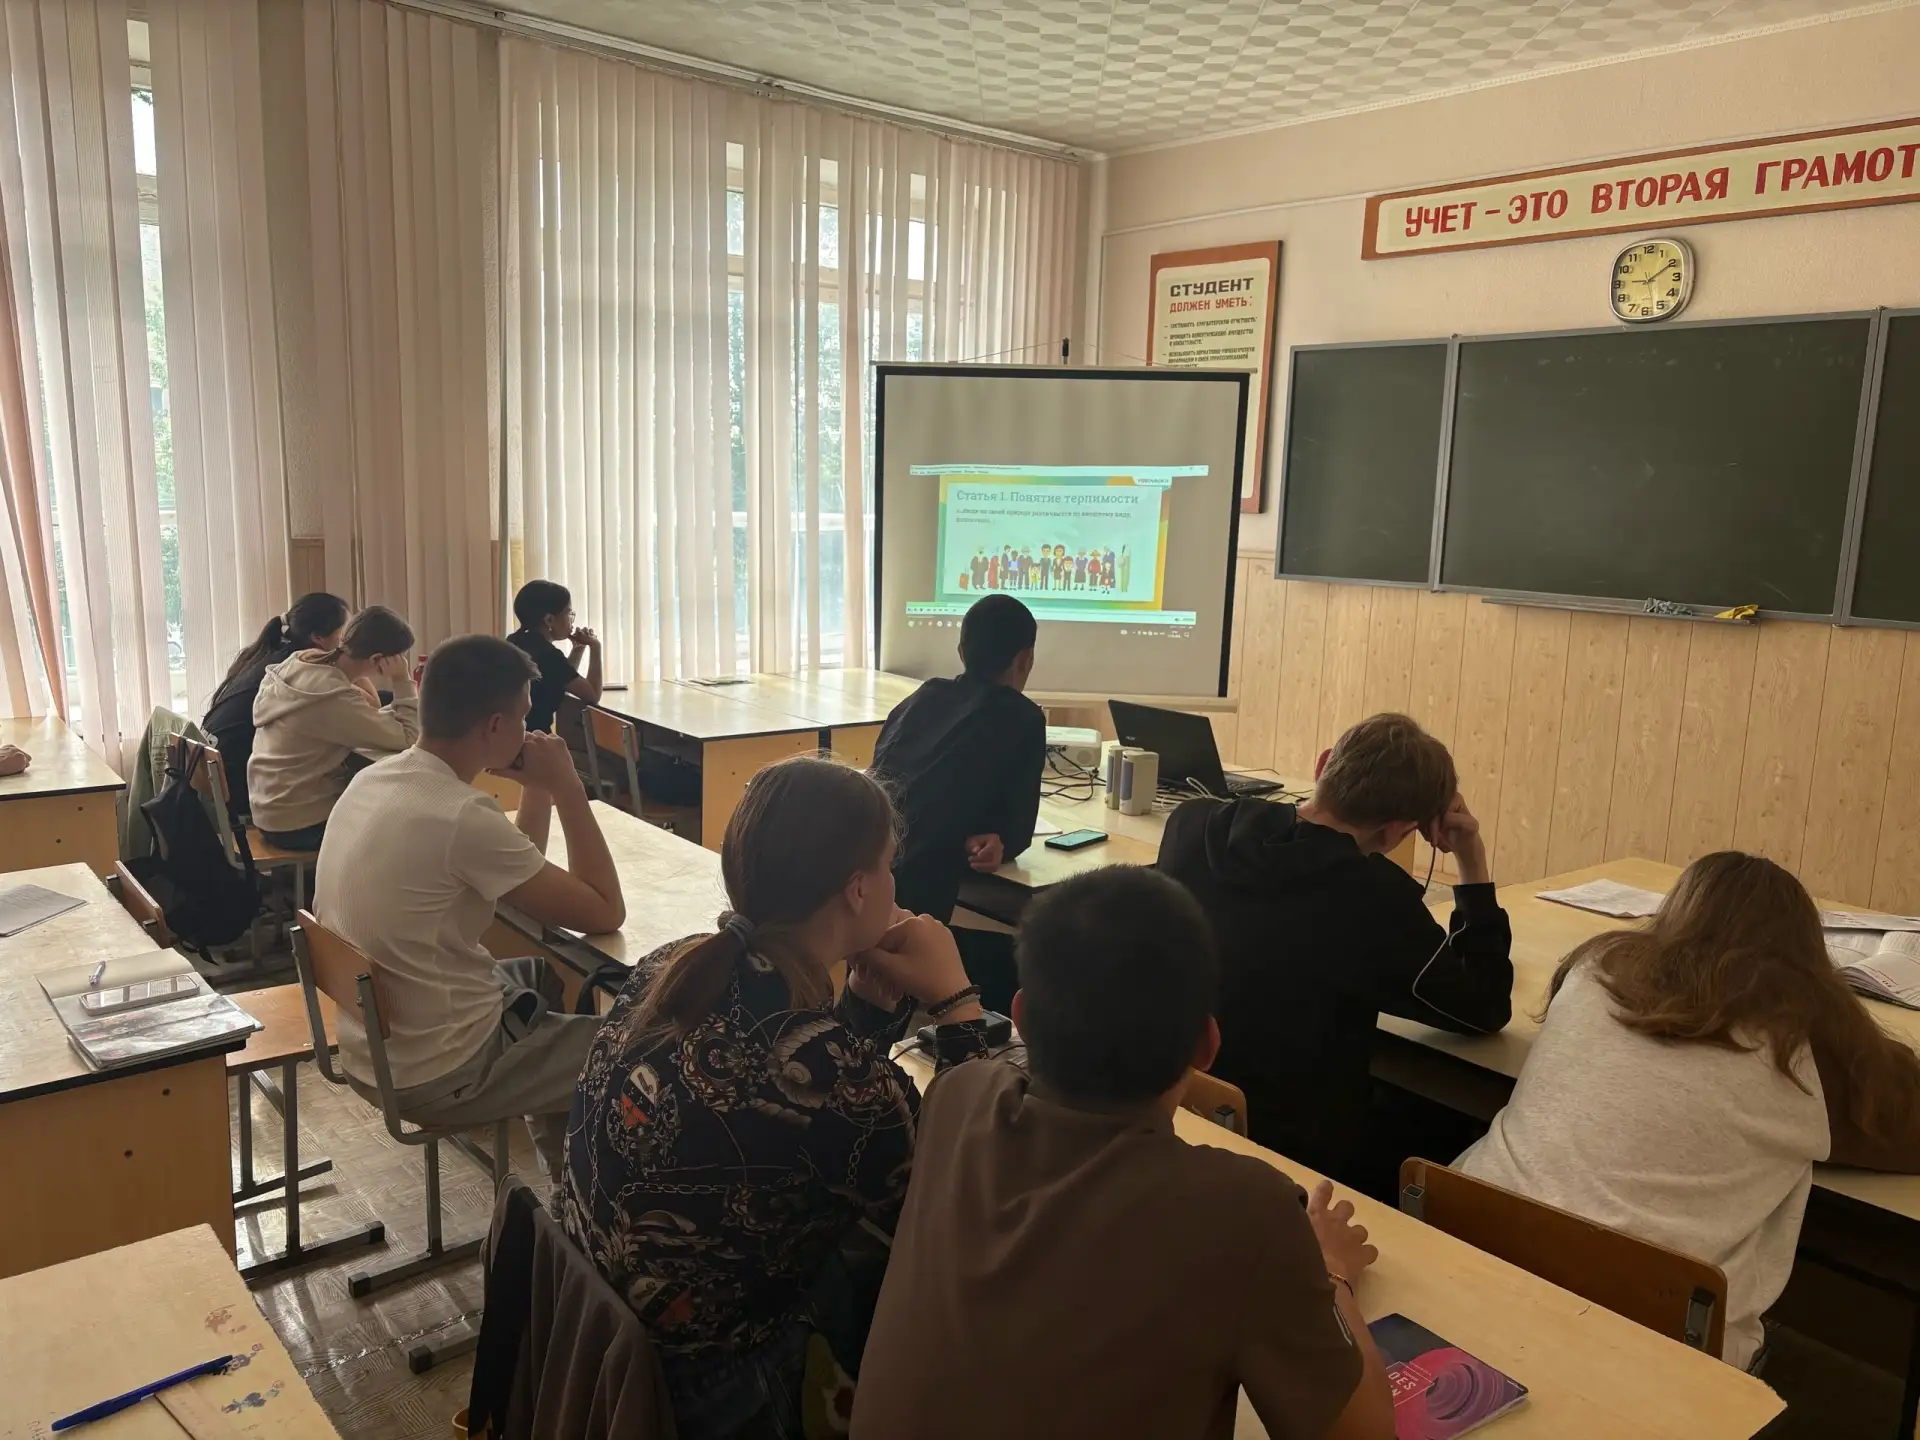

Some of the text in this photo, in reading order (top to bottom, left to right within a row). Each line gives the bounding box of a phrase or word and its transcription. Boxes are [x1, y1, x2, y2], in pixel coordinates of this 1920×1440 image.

[1405, 202, 1477, 237] УЧЕТ
[1508, 189, 1568, 224] ЭТО
[1591, 167, 1729, 213] ВТОРАЯ
[1755, 143, 1920, 194] ГРАМОТ
[1644, 245, 1655, 254] 12
[1660, 250, 1664, 258] 1
[1629, 254, 1638, 262] 11
[1668, 259, 1676, 268] 2
[1619, 265, 1629, 274] 10
[1672, 272, 1681, 281] 3
[1170, 277, 1254, 297] СТУДЕНТ
[1666, 288, 1675, 297] 4
[1618, 294, 1626, 302] 8
[1170, 300, 1210, 313] ДОЛЖЕН
[1628, 304, 1636, 313] 7
[1656, 301, 1664, 310] 5
[1641, 307, 1649, 316] 6
[957, 490, 997, 501] Статья
[1011, 492, 1061, 503] Понятие
[1064, 494, 1139, 505] терпимости
